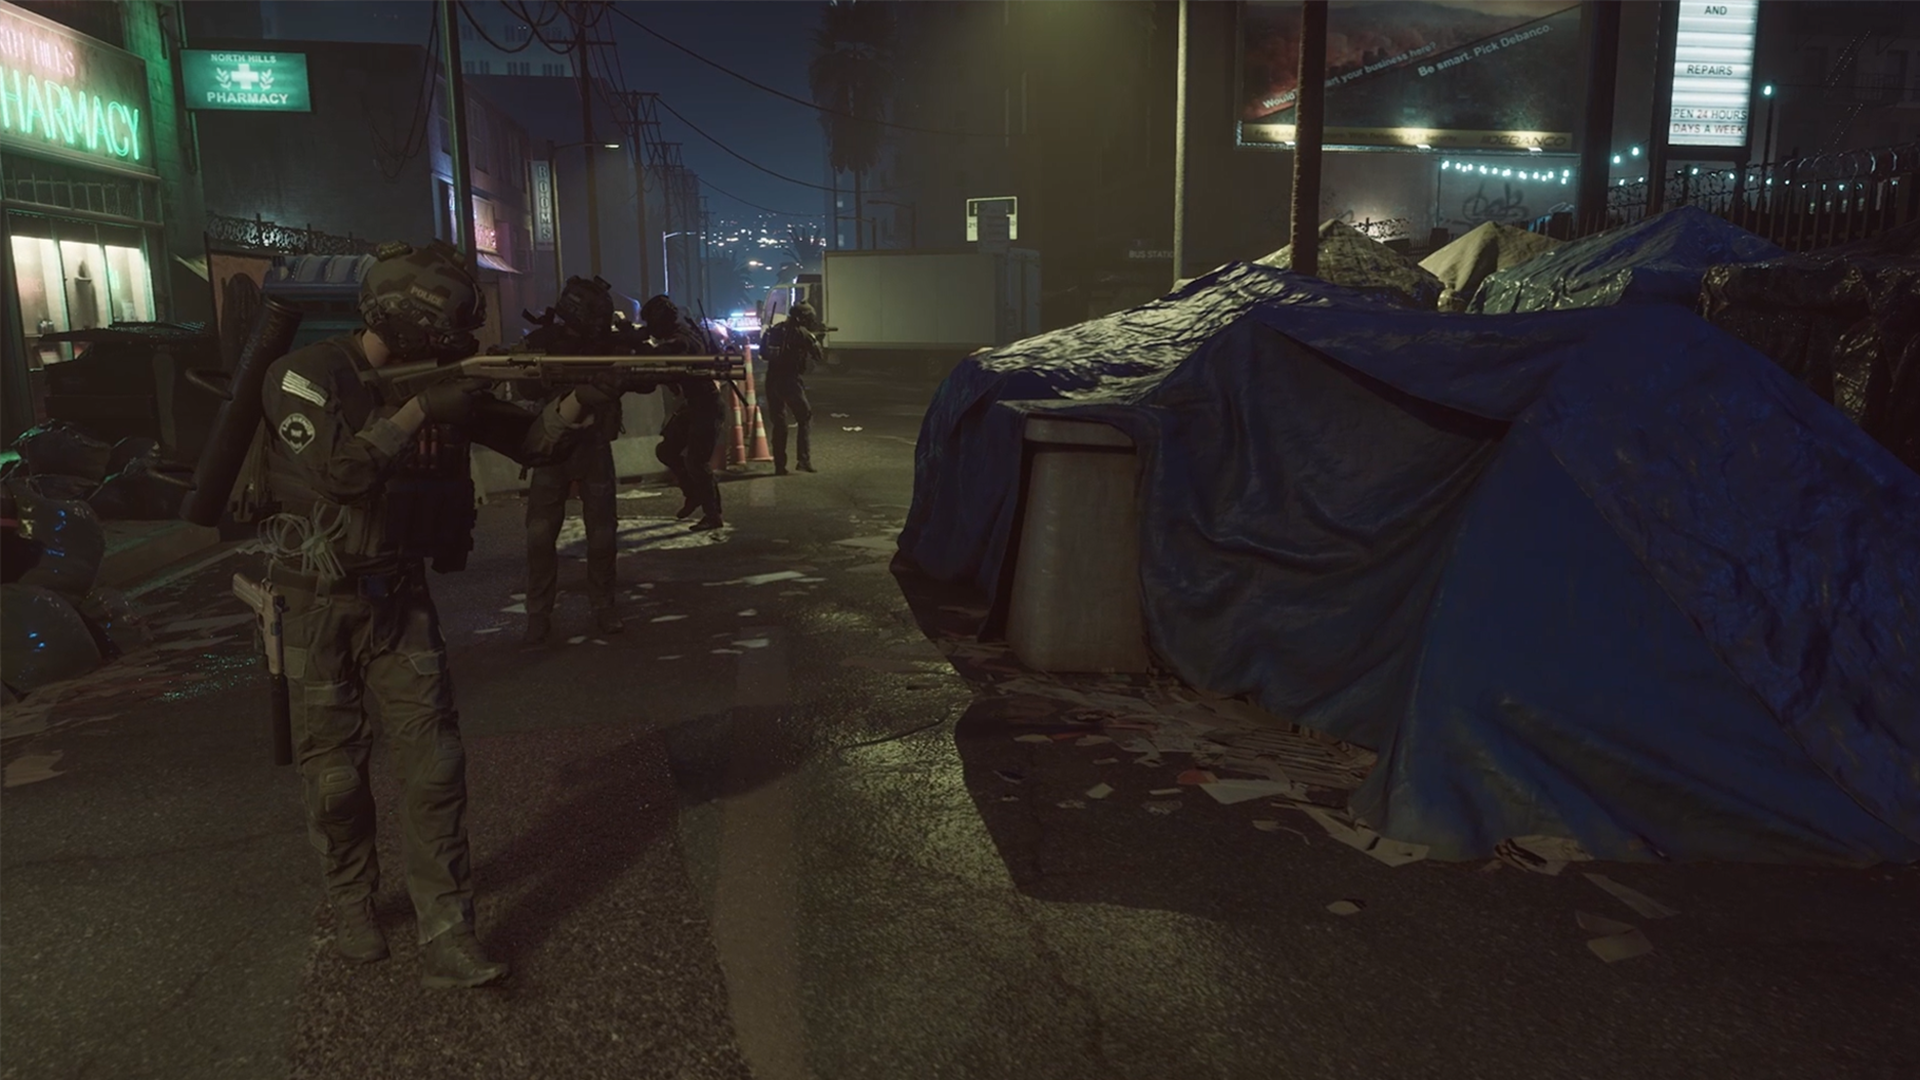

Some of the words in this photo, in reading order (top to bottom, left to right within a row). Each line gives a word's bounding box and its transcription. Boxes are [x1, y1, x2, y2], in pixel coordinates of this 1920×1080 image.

[1704, 5, 1728, 15] AND
[1417, 65, 1435, 77] Be
[1436, 52, 1473, 71] smart.
[1473, 42, 1500, 57] Pick
[1500, 24, 1553, 48] Debanco.
[32, 37, 75, 78] HILLS
[210, 53, 246, 63] NORTH
[248, 54, 277, 64] HILLS
[1262, 92, 1295, 109] Would
[1341, 68, 1363, 84] your
[1364, 52, 1408, 73] business
[1409, 41, 1437, 57] here?
[1686, 64, 1733, 76] REPAIRS
[206, 91, 289, 105] PHARMACY
[0, 66, 139, 160] HARMACY
[1673, 108, 1693, 119] PEN
[1696, 109, 1708, 119] 24
[1711, 109, 1747, 120] HOURS
[1672, 123, 1700, 133] DAYS
[1704, 124, 1711, 133] A
[1714, 124, 1745, 135] WEEK
[1485, 134, 1567, 147] DEBANCO
[538, 165, 551, 240] ROOMS
[1128, 249, 1146, 259] BUS
[410, 286, 444, 307] POLICE
